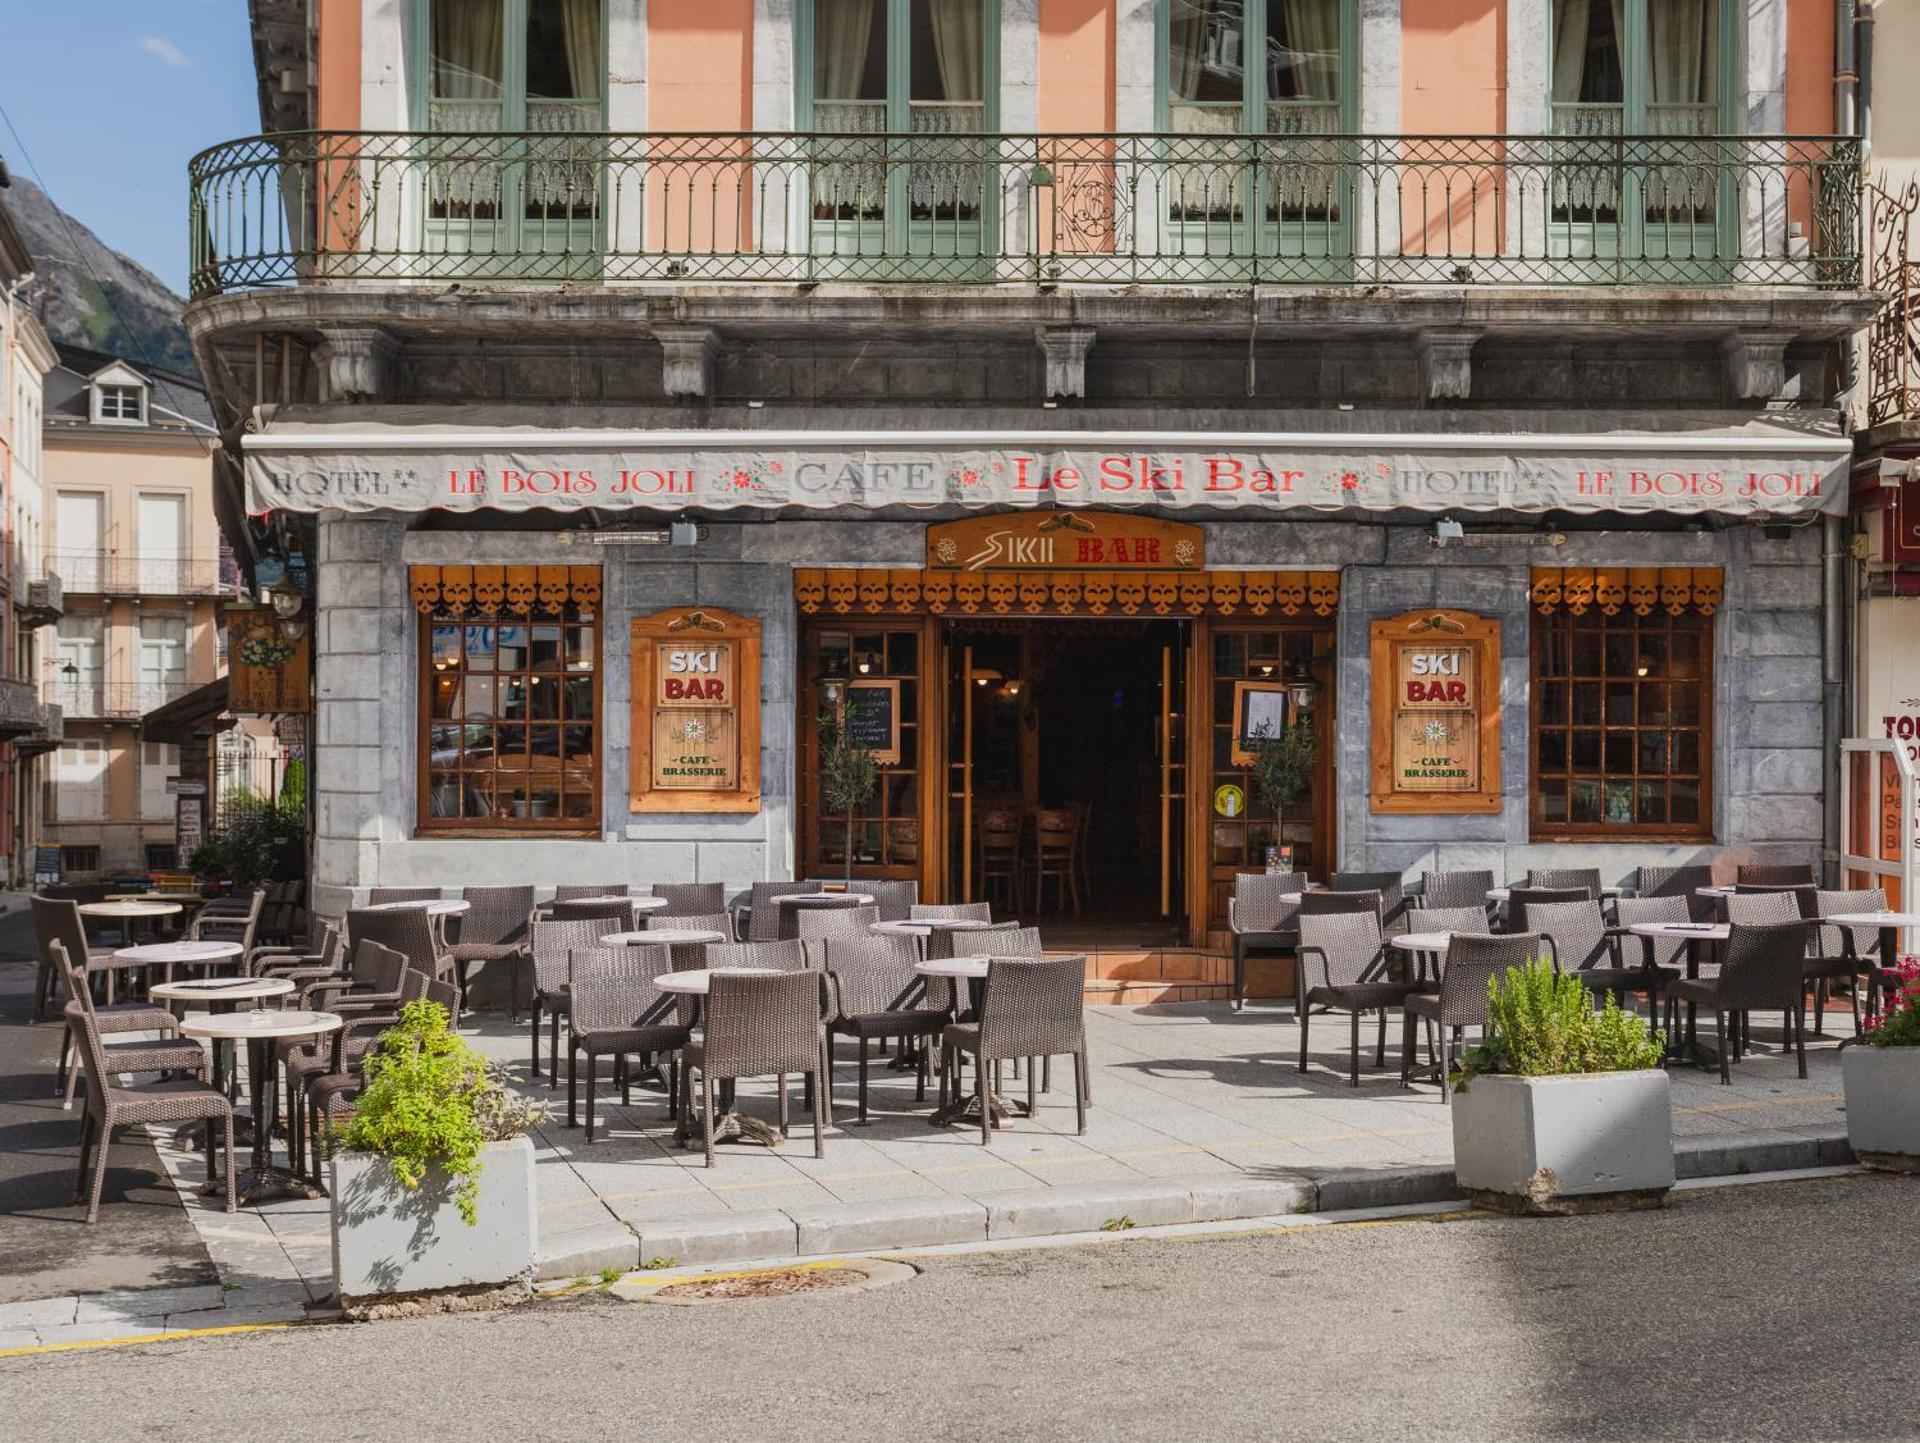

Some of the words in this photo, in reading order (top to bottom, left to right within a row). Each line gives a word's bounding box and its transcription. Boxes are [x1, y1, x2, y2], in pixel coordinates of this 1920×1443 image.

[271, 470, 389, 496] HOTEL
[448, 470, 485, 494] LE
[501, 470, 597, 494] BOIS
[611, 470, 696, 494] JOLI
[795, 462, 934, 493] CAFE
[1011, 457, 1080, 491] Le
[1099, 457, 1185, 491] Ski
[1204, 458, 1305, 493] Bar
[1401, 470, 1518, 495] HOTEL
[1577, 471, 1613, 496] LE
[1630, 471, 1725, 497] BOIS
[1738, 472, 1825, 498] JOLI
[1076, 537, 1161, 563] BAR
[670, 651, 718, 674] SKI
[1411, 653, 1461, 677] SKI
[664, 677, 725, 701] BAR
[1406, 680, 1467, 703] BAR
[662, 767, 727, 777] BRASSERIE
[679, 755, 710, 765] CAFE
[1421, 757, 1451, 767] CAFE
[1404, 769, 1470, 778] BRASSERIE
